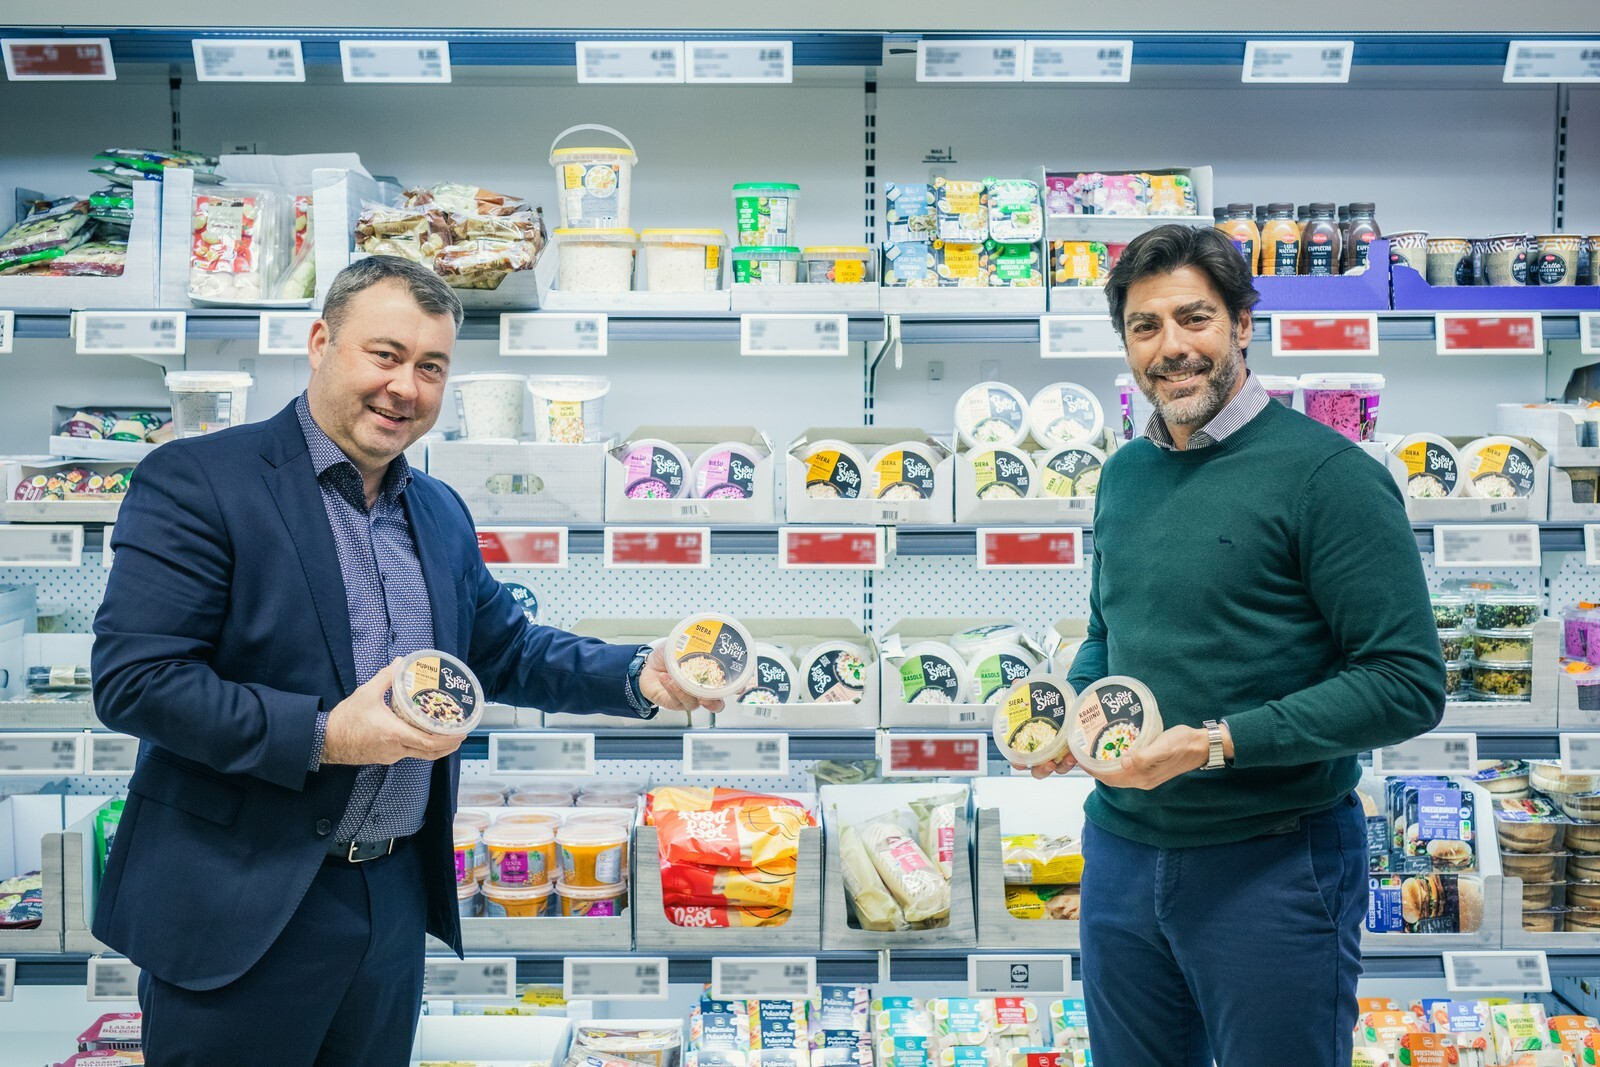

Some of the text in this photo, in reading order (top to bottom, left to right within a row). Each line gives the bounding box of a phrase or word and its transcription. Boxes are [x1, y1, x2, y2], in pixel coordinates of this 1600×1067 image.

[1405, 449, 1420, 457] SIERA
[815, 454, 831, 464] SIERA
[695, 624, 712, 636] SIERA
[903, 673, 923, 682] RASOLS
[1008, 697, 1024, 707] SIERA
[1079, 704, 1099, 718] KRABJU
